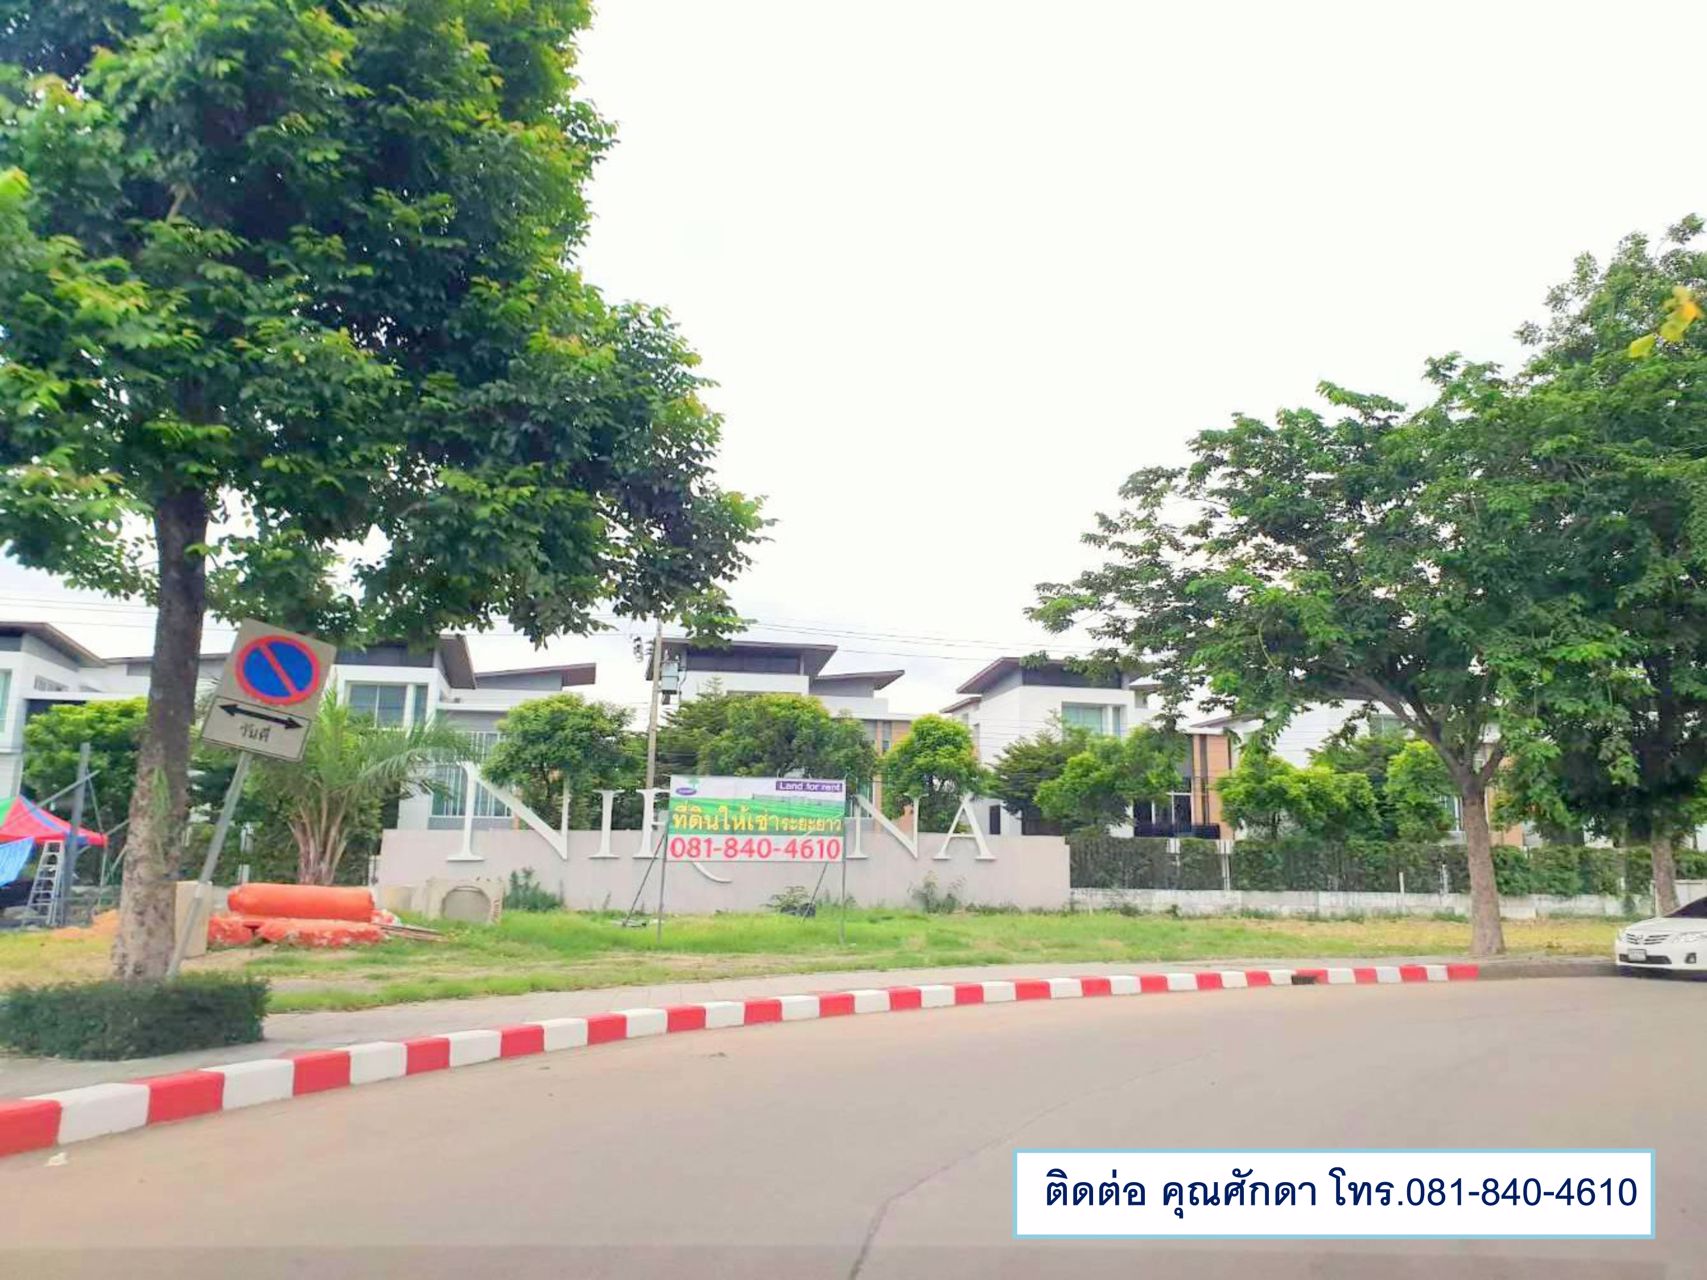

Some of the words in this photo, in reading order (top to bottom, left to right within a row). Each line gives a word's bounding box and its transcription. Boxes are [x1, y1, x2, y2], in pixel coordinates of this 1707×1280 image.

[779, 782, 803, 791] Land
[806, 783, 818, 791] for
[820, 783, 841, 792] rent
[669, 836, 841, 860] 081-840-4610
